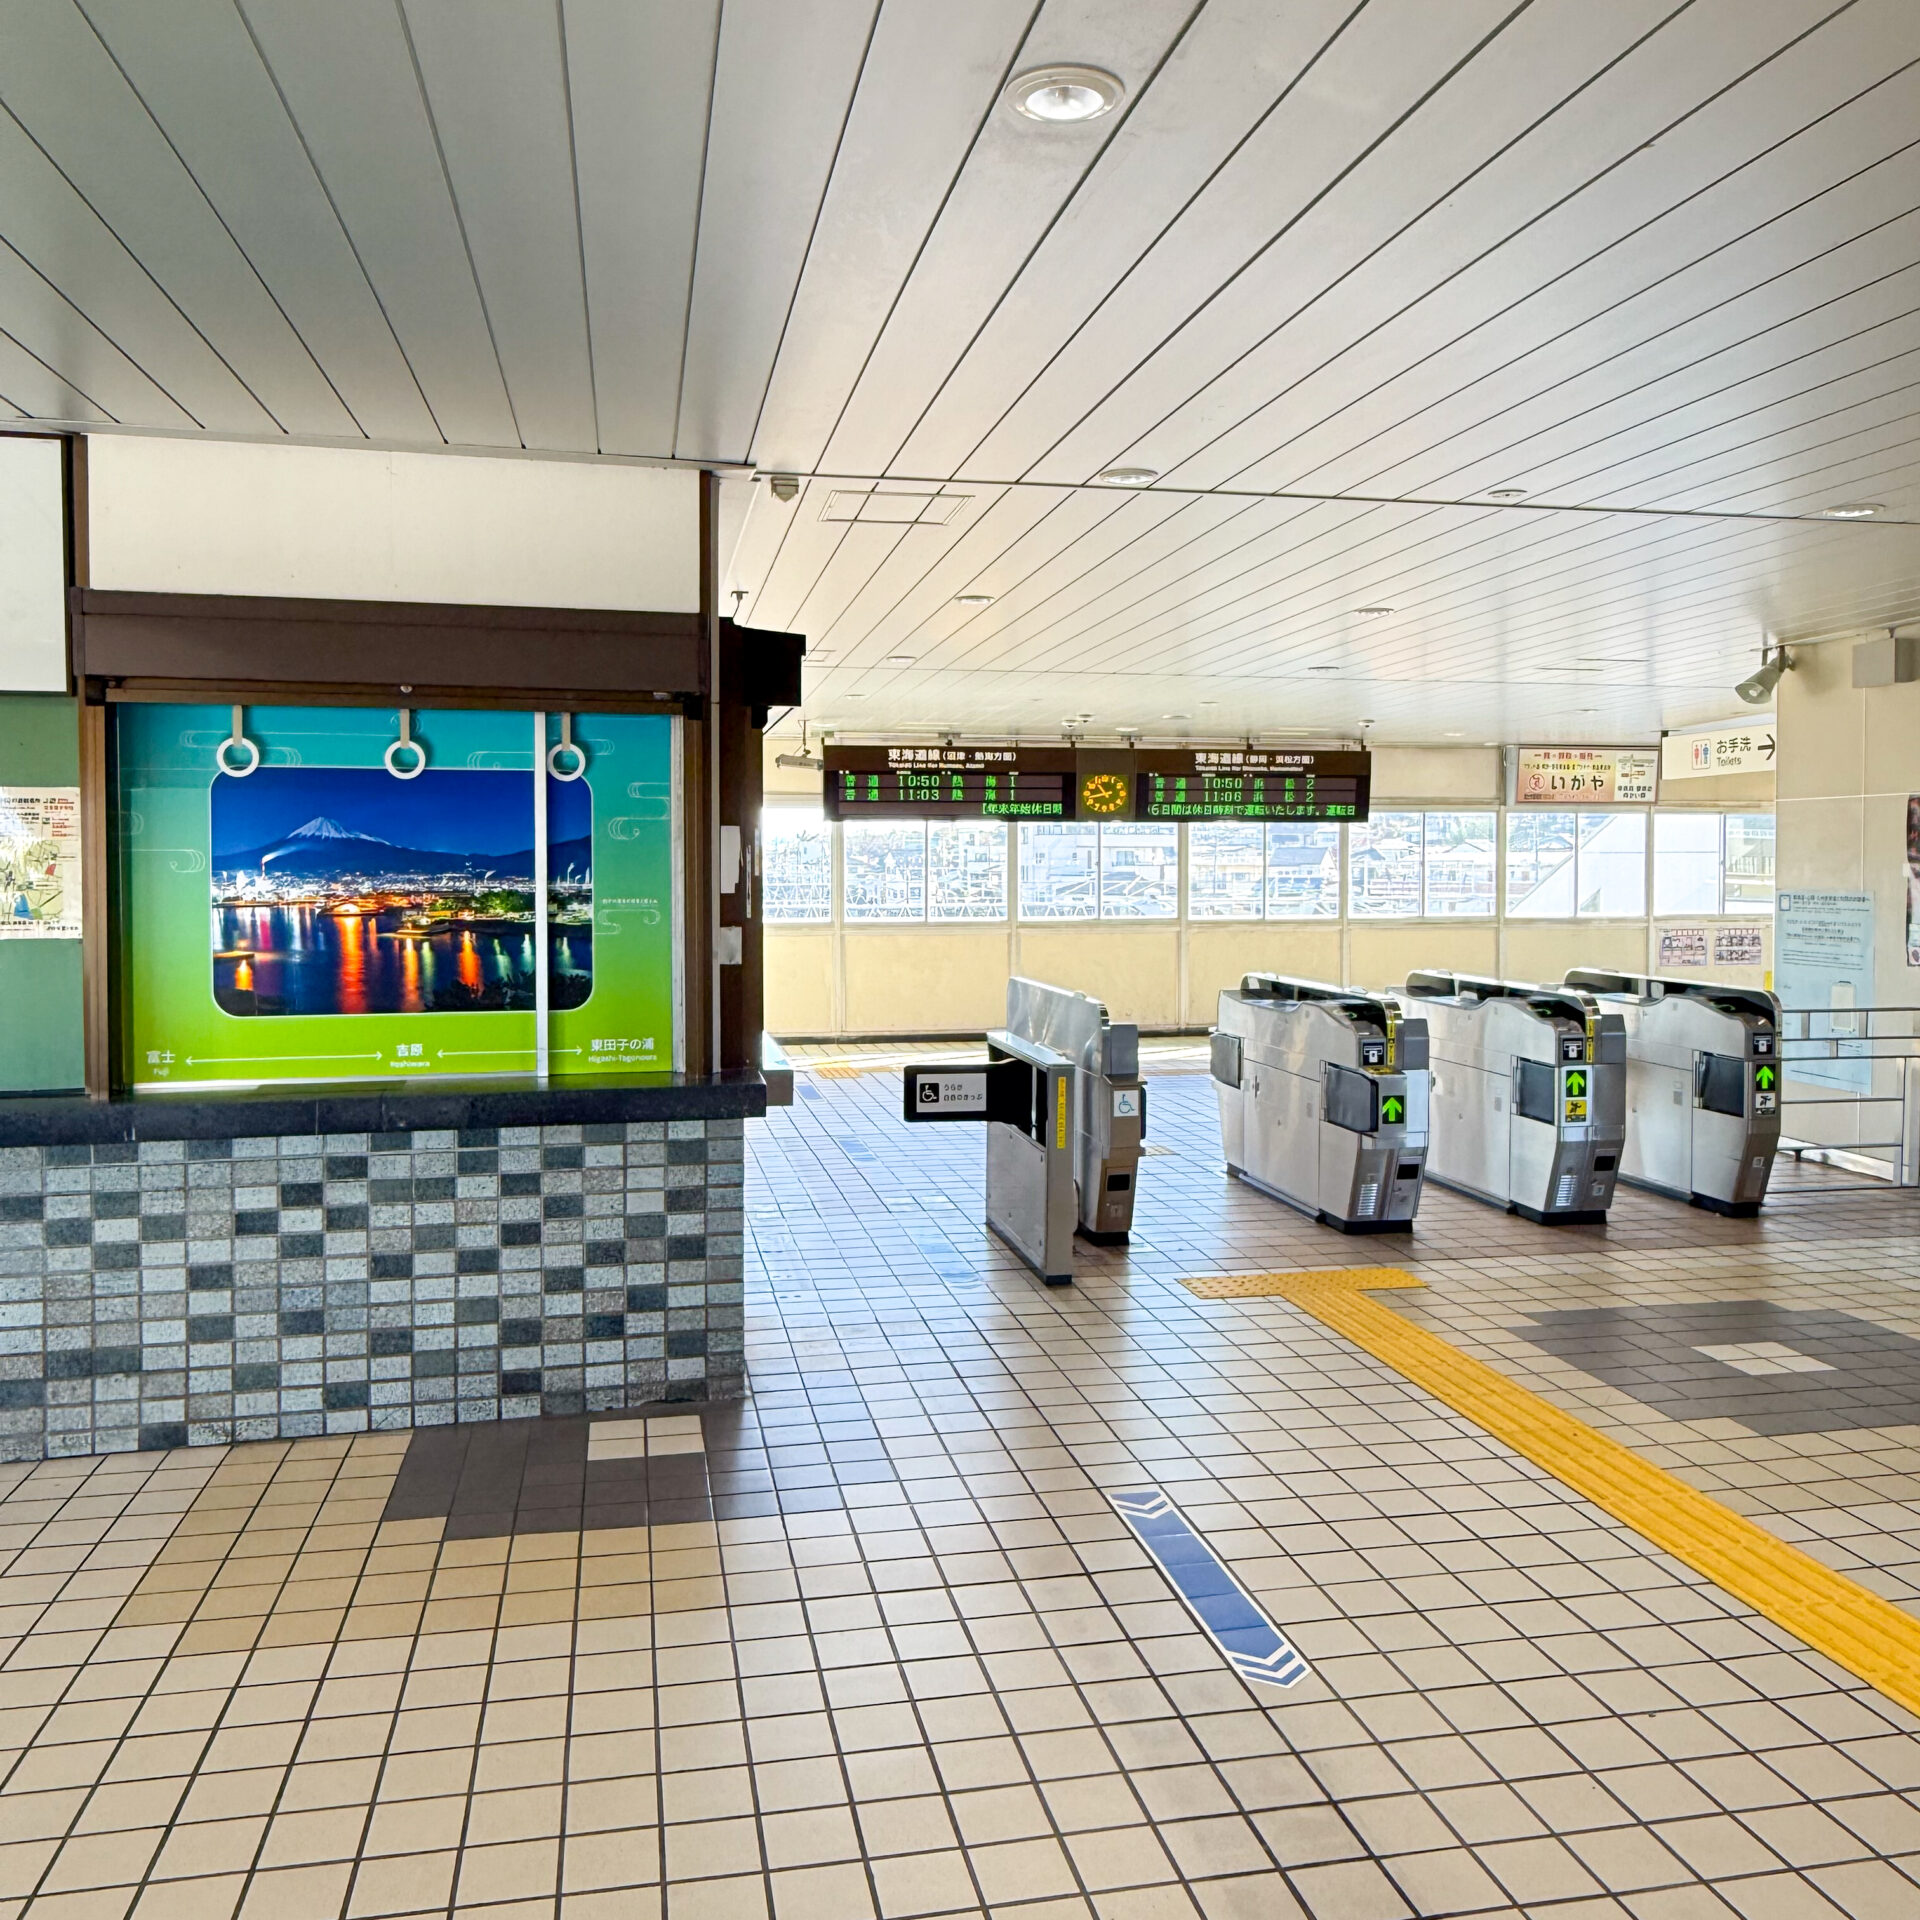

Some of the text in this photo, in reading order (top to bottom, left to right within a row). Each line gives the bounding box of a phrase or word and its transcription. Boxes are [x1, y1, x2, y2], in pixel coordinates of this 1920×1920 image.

[1717, 736, 1751, 754] お手洗
[1716, 757, 1742, 767] Toilets
[899, 775, 940, 787] 10:50
[1306, 779, 1315, 789] 2
[1551, 774, 1604, 791] いがや
[899, 789, 940, 801] 11:03
[1306, 792, 1314, 802] 2
[396, 1043, 423, 1057] 吉原
[591, 1038, 654, 1052] 東田子の浦
[146, 1050, 176, 1065] 富士
[153, 1067, 170, 1077] Fuji
